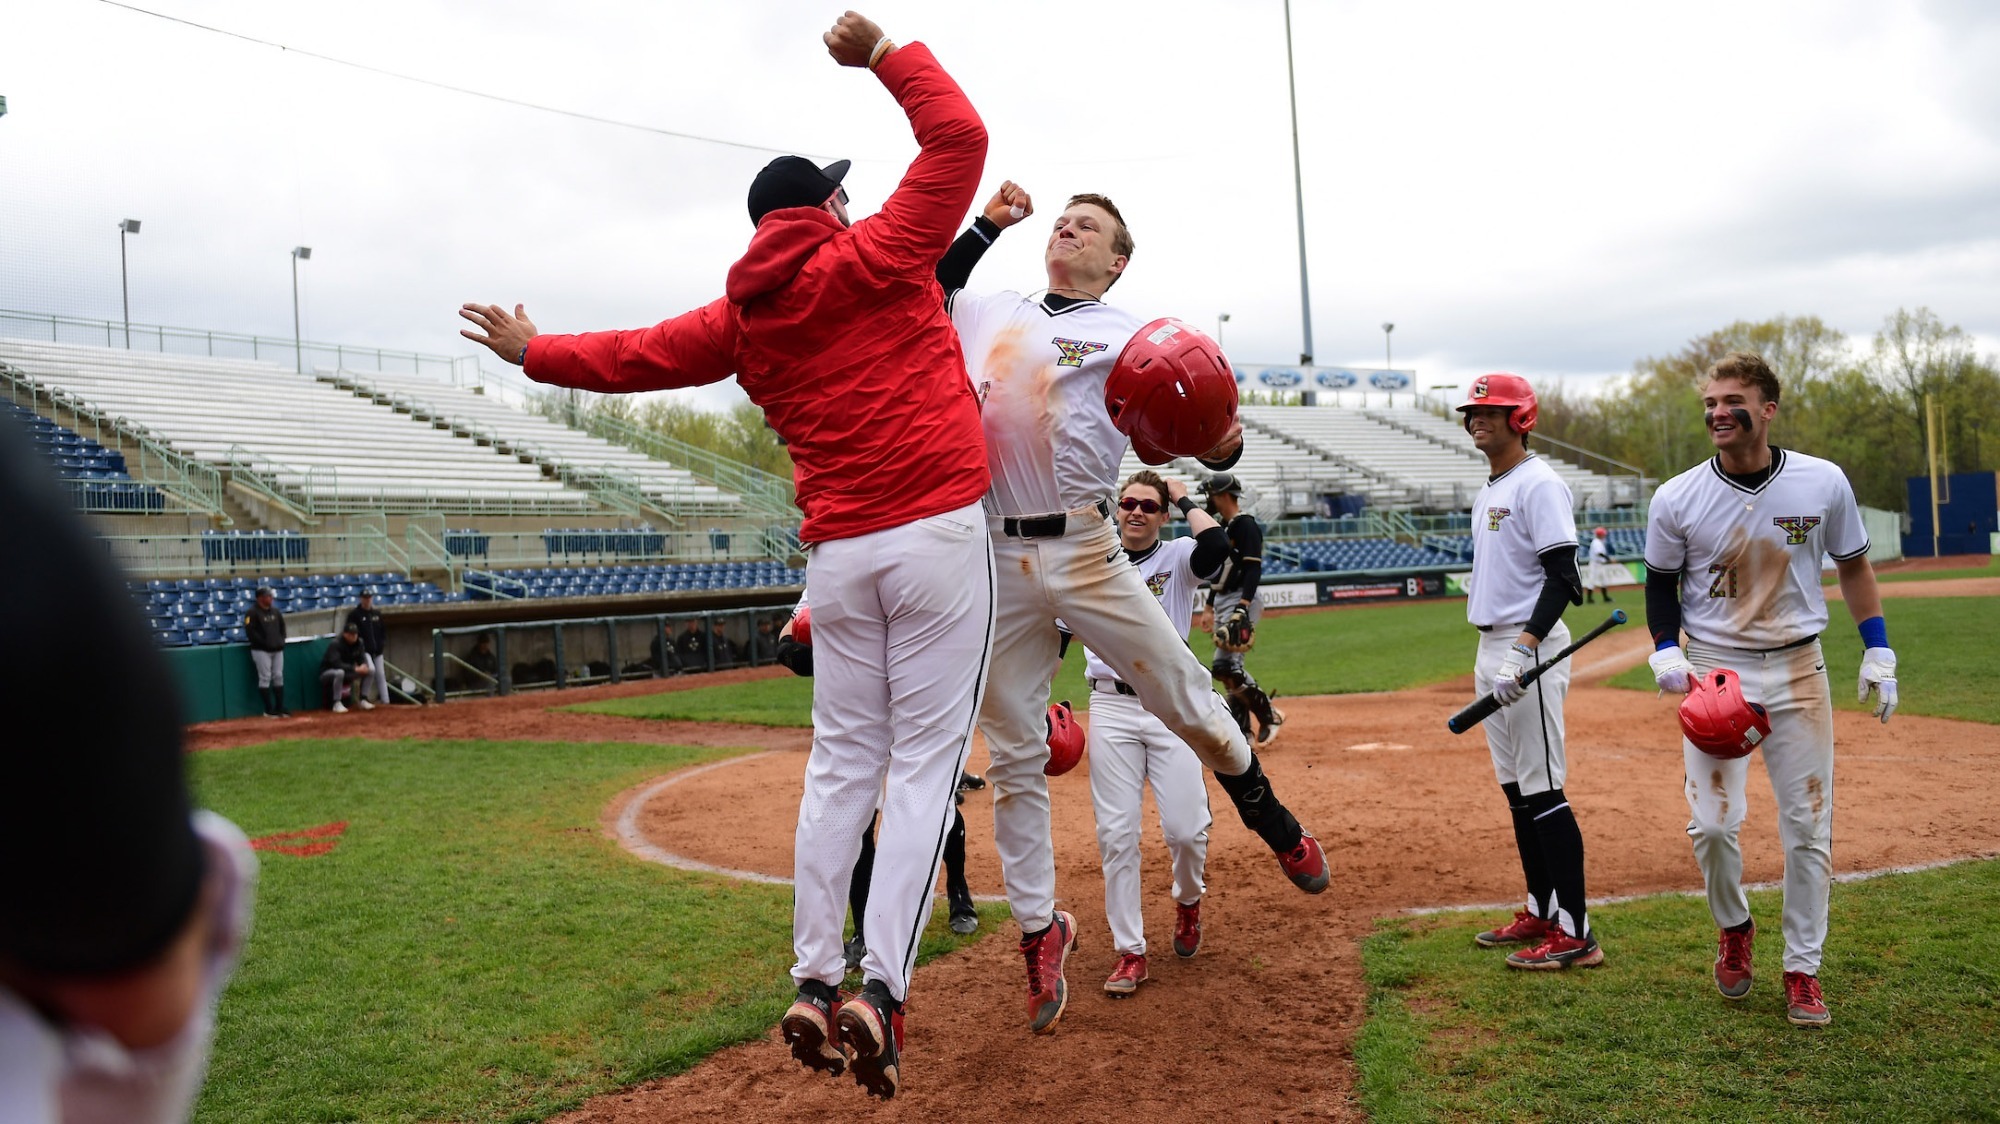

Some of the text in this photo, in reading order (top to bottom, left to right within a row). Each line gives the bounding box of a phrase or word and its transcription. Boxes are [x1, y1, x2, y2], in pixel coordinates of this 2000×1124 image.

[1051, 337, 1109, 368] Y
[1487, 506, 1511, 531] Y
[1773, 516, 1821, 545] Y
[1708, 564, 1738, 599] 21
